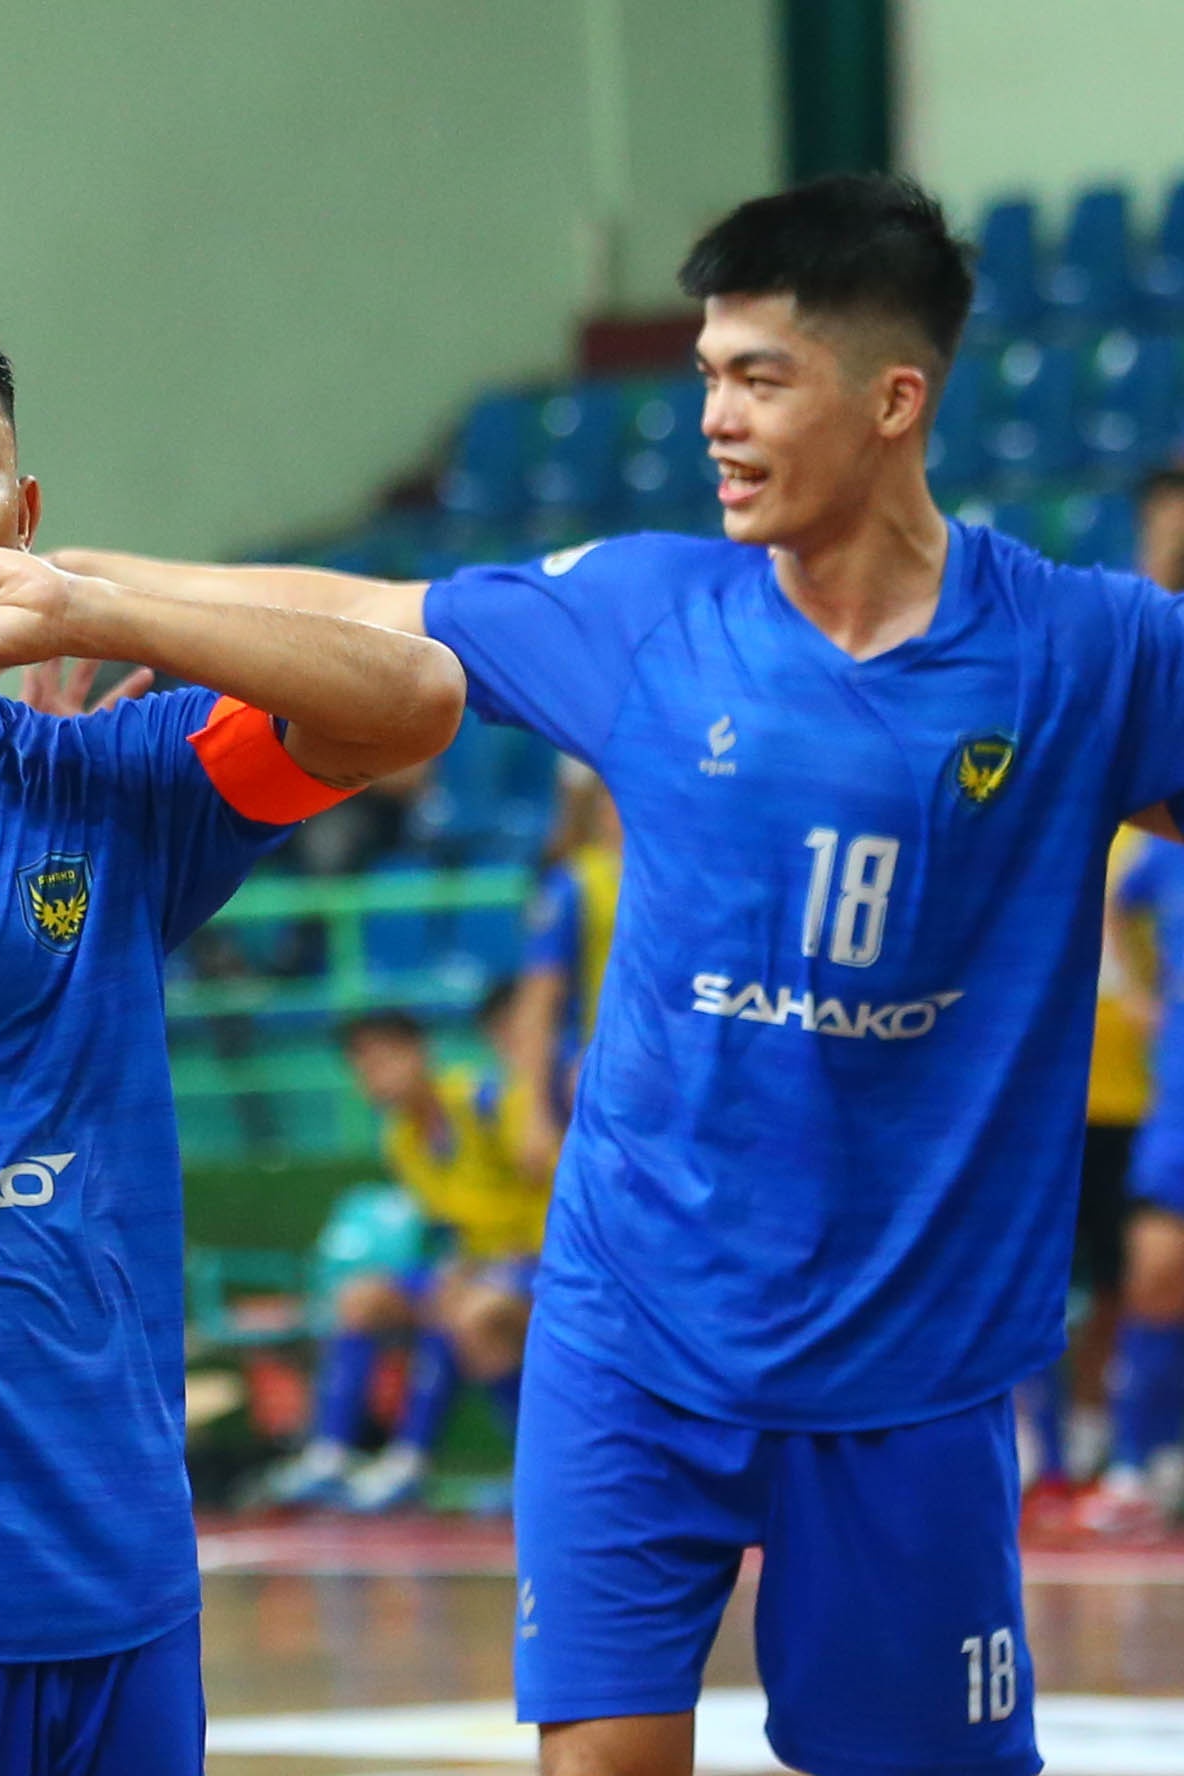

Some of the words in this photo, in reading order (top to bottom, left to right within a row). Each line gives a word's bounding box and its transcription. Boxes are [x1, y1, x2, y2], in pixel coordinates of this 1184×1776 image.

[803, 826, 900, 968] 18
[691, 973, 965, 1041] SAHAKO
[960, 1626, 1016, 1724] 18
